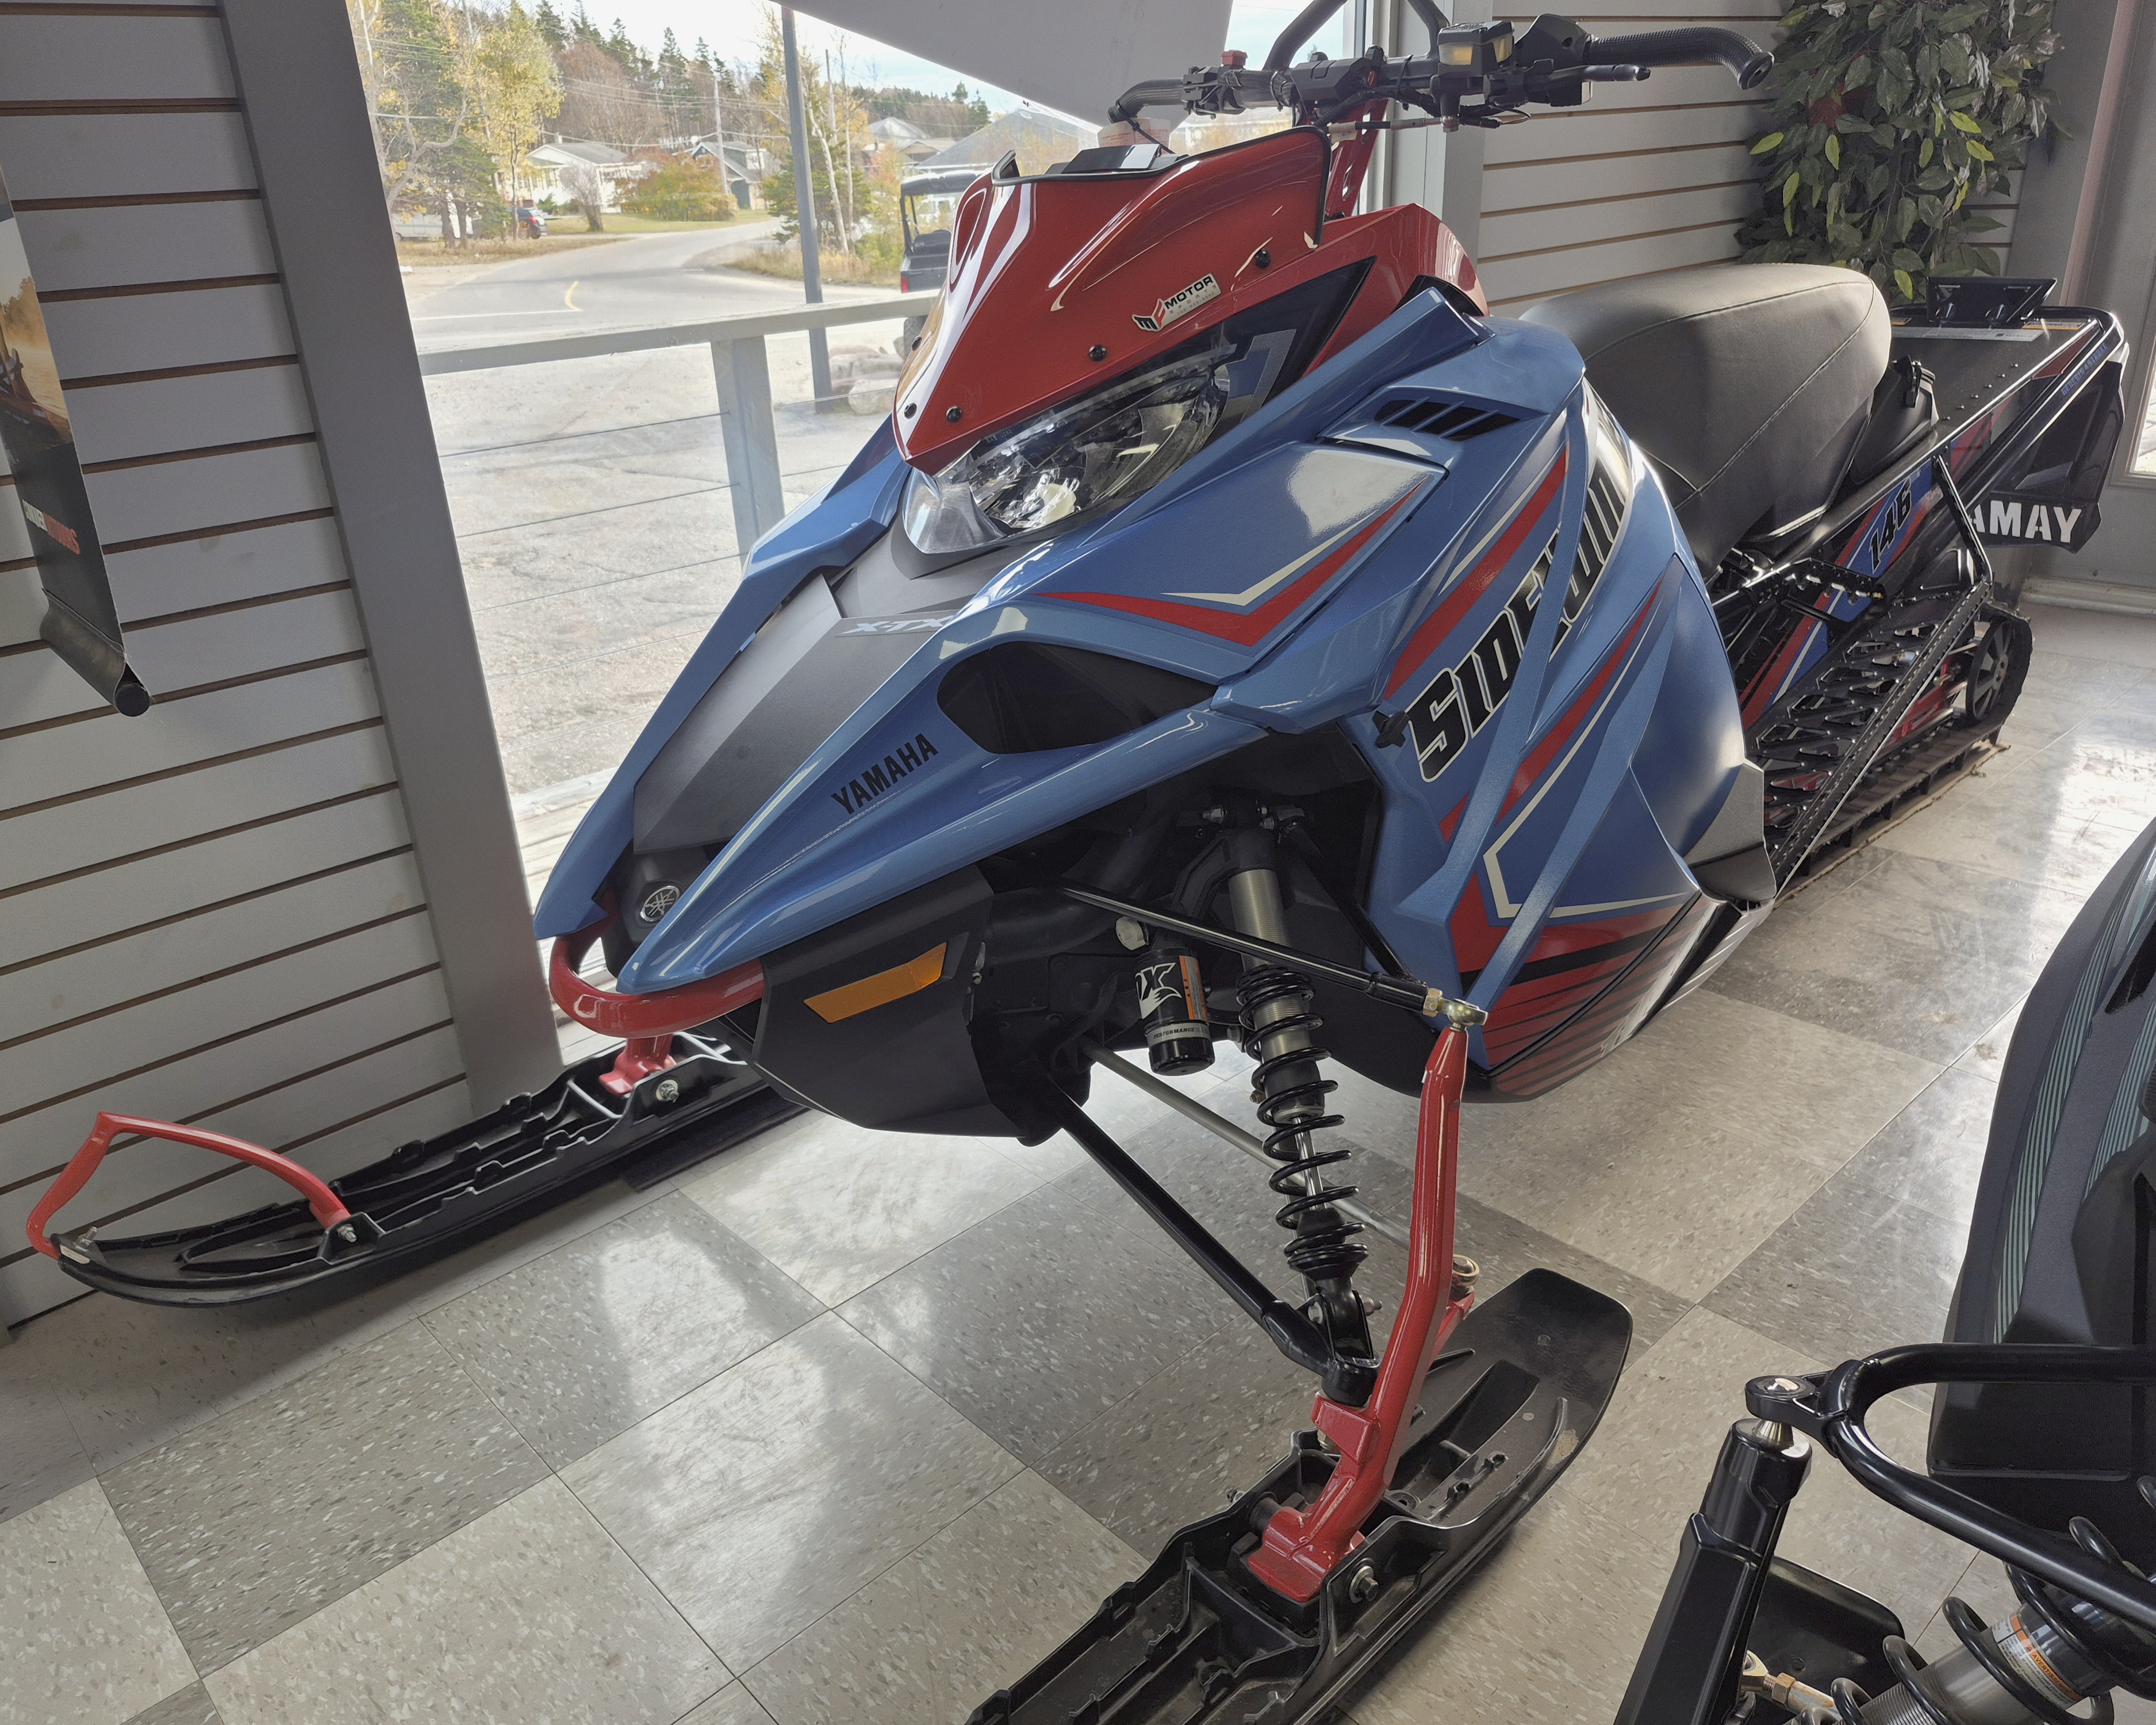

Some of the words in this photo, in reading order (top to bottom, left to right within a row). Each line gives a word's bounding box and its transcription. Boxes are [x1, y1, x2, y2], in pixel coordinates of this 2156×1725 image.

[1164, 275, 1214, 309] MOTOR
[1169, 285, 1217, 315] SPORTS
[1869, 477, 1912, 574] 146
[831, 733, 939, 815] YAMAHA
[1153, 1028, 1195, 1039] PERFORMANCE
